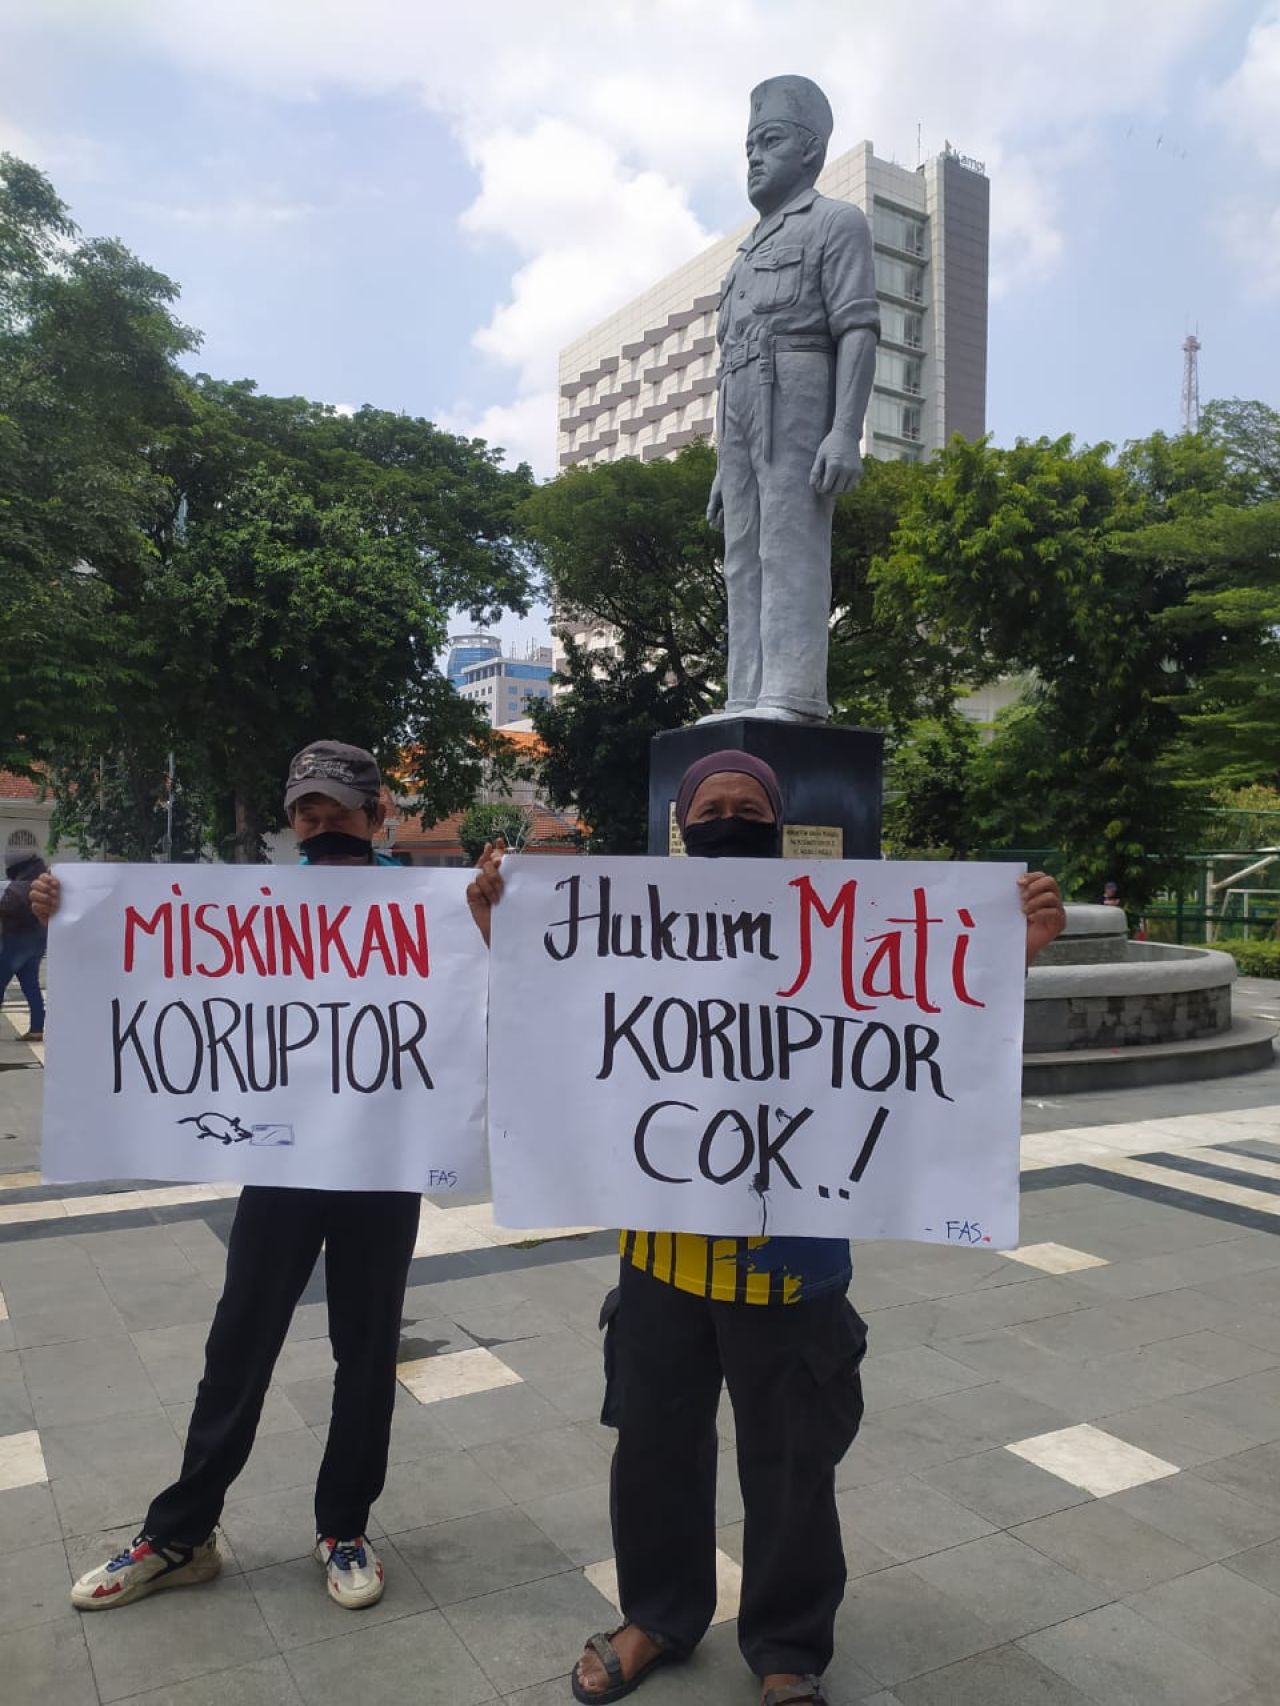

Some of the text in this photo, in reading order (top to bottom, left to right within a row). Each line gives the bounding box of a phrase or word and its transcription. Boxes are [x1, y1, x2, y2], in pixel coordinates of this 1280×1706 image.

[543, 875, 986, 1013] Hukum Mati
[112, 997, 434, 1095] KORUPTOR
[596, 991, 955, 1102] KORUPTOR
[429, 1169, 458, 1188] FAS
